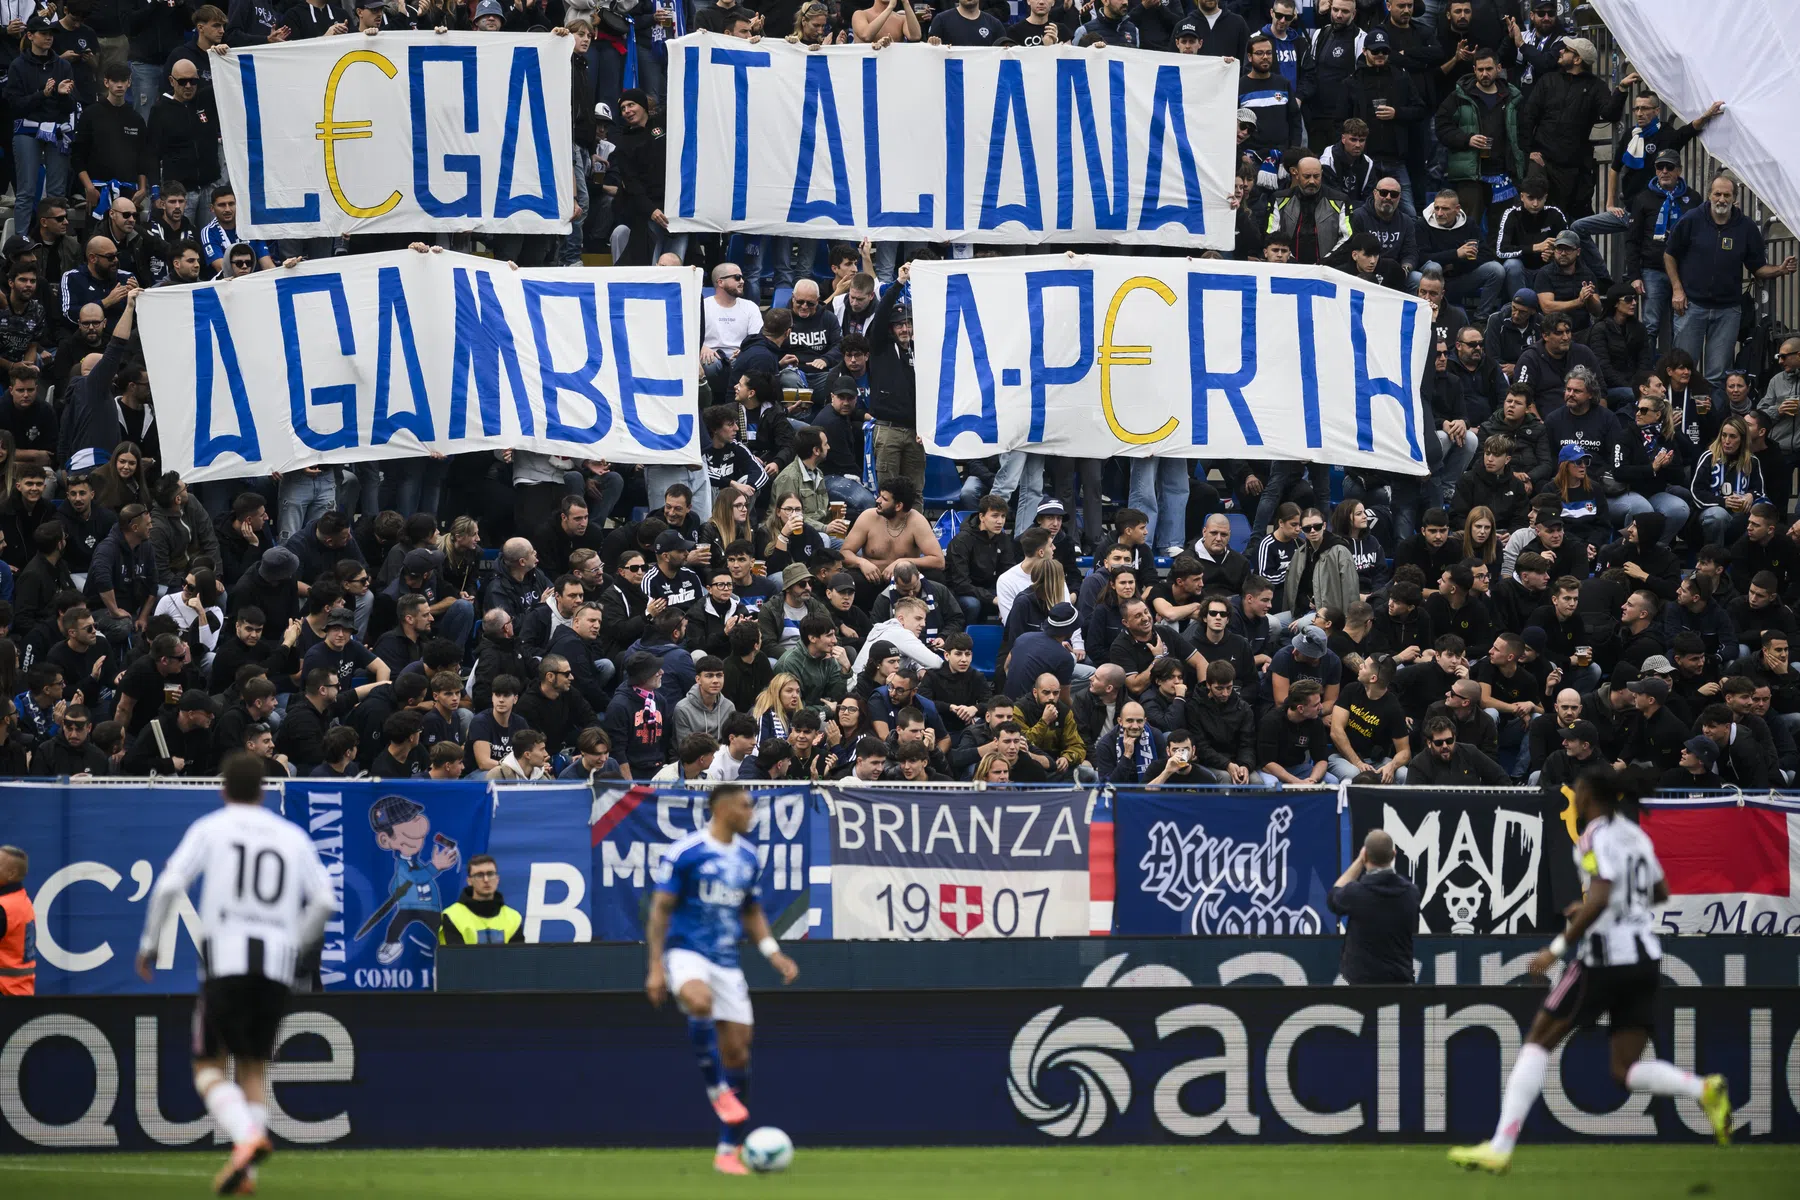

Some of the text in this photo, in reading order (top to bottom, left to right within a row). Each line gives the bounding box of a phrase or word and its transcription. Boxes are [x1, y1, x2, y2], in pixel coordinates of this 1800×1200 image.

[680, 47, 1204, 234] ITALIANA
[231, 842, 285, 904] 10
[834, 800, 1082, 857] BRIANZA
[1383, 802, 1543, 922] MAD
[354, 968, 413, 988] COMO
[1153, 1003, 1800, 1137] acinqu
